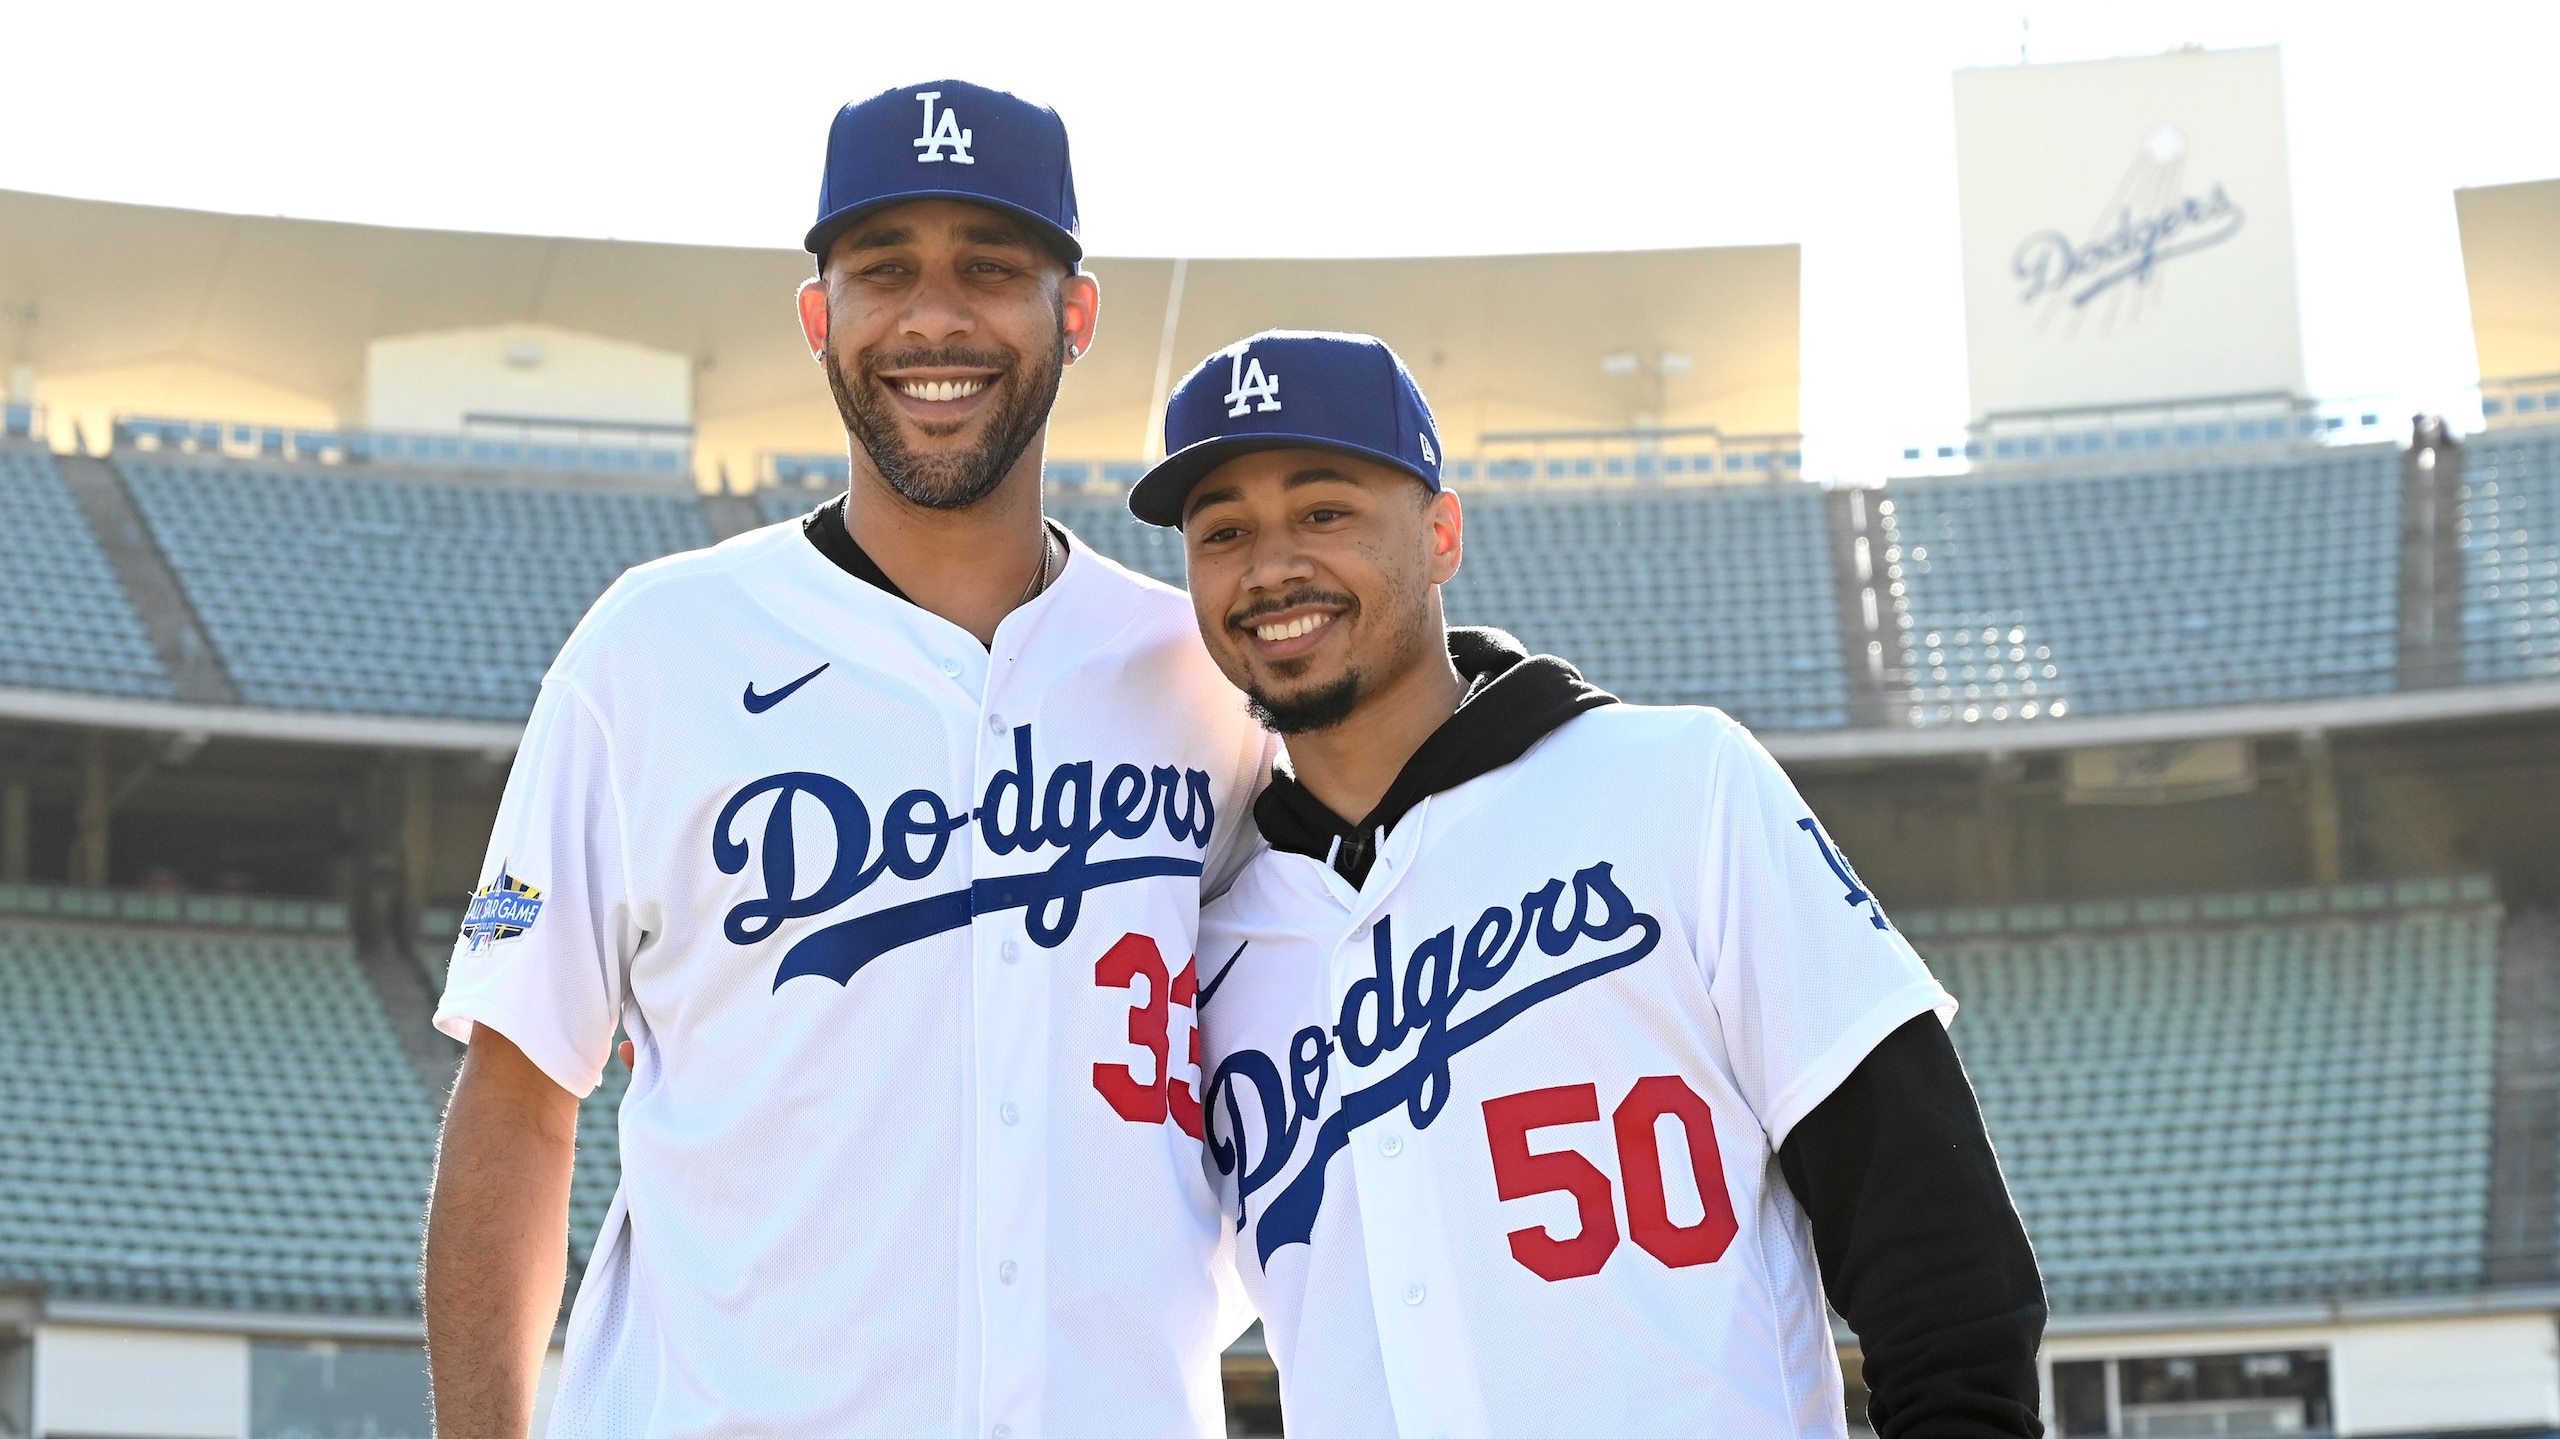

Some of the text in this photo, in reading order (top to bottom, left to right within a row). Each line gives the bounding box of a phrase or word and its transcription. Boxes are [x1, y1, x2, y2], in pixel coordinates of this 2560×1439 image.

[913, 91, 975, 165] LA
[2012, 182, 2244, 306] Dodgers
[1224, 344, 1282, 419] LA
[713, 724, 1215, 970] Dodgers
[498, 897, 539, 923] GAME
[1206, 861, 1660, 1250] Dodgers
[1481, 1075, 1739, 1282] 50
